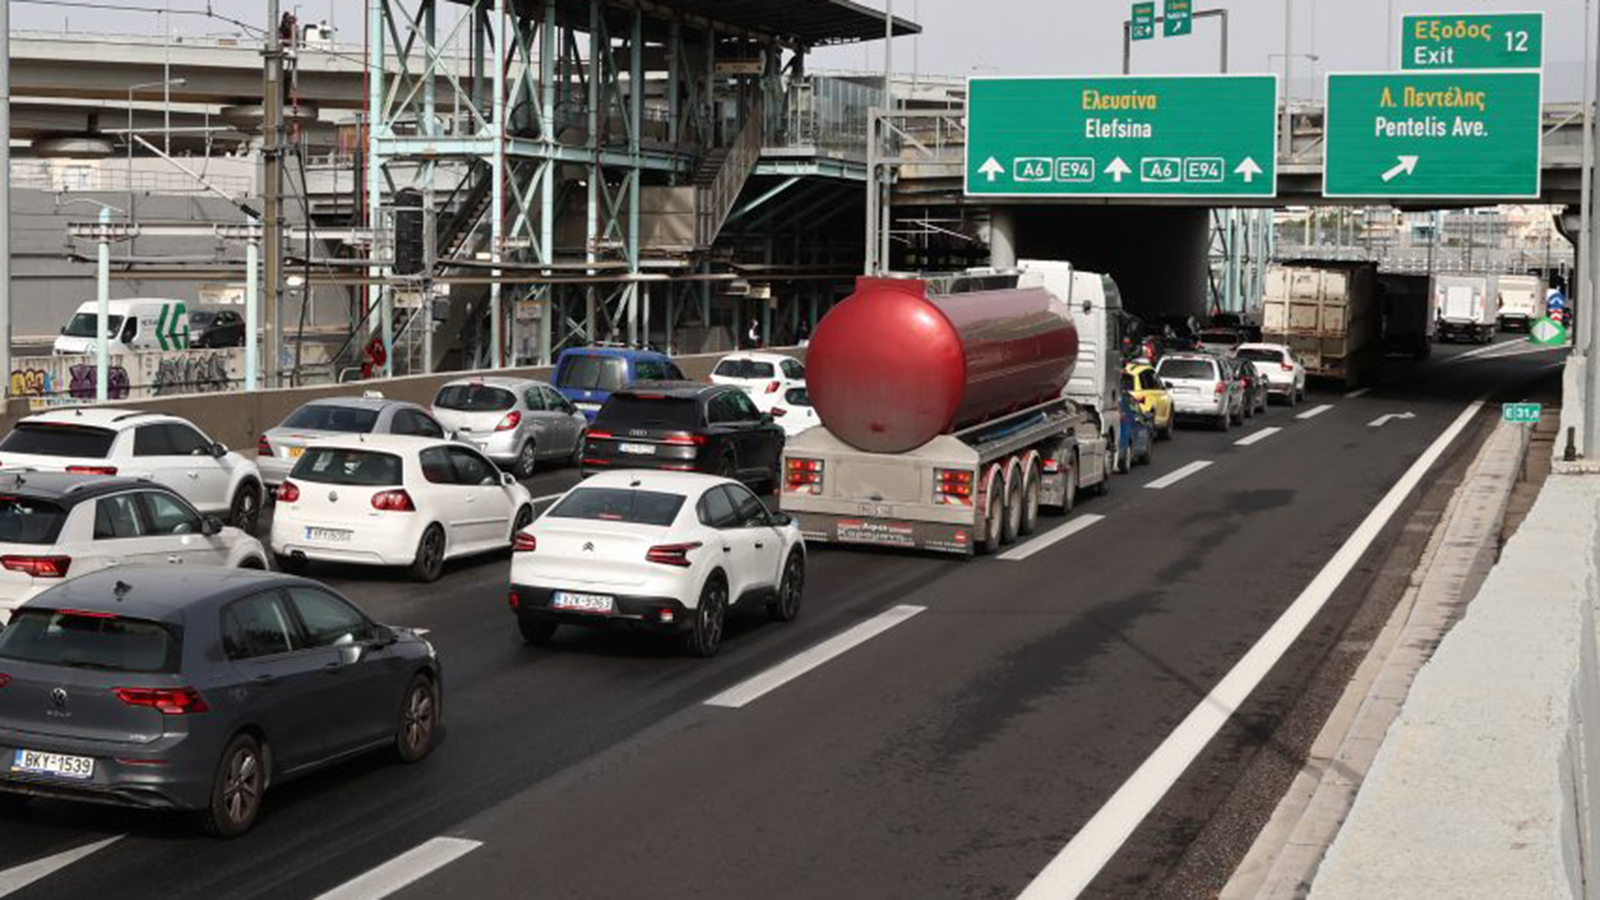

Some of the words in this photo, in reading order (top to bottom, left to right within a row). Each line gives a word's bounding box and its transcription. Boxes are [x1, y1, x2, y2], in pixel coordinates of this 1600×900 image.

[1505, 31, 1528, 51] 12
[1414, 46, 1454, 64] Exit
[1082, 89, 1157, 110] Ελευσίνα
[1380, 86, 1397, 107] Λ.
[1404, 86, 1486, 111] Πεντέλης
[1085, 118, 1152, 138] Elefsina
[1375, 116, 1447, 137] Pentelis
[1451, 116, 1488, 137] Ave.
[1022, 163, 1044, 177] A6
[1060, 163, 1089, 177] E94
[1150, 163, 1173, 177] A6
[1189, 163, 1219, 177] E94
